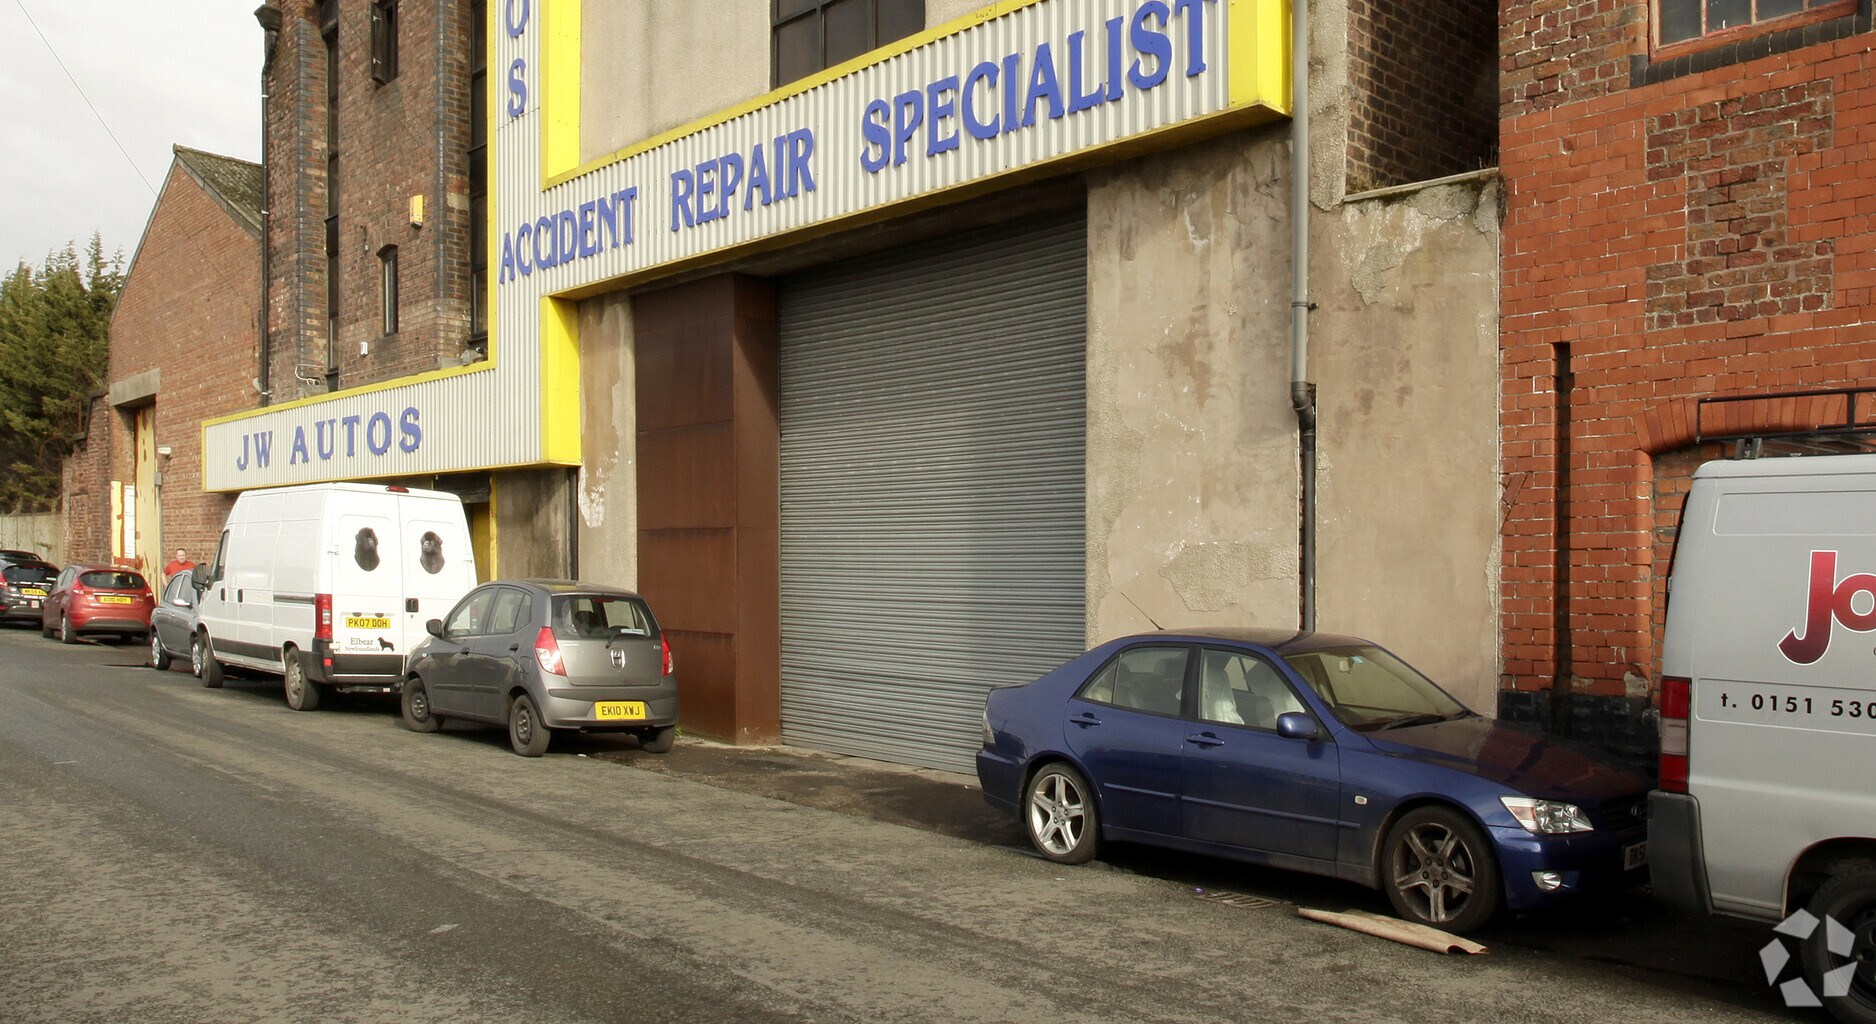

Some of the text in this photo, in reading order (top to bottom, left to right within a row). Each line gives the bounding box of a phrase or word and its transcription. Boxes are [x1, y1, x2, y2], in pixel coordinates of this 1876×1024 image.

[499, 185, 638, 284] ACCIDENT
[670, 127, 817, 232] REPAIR
[236, 406, 422, 471] JW AUTOS
[350, 637, 374, 645] Elbear
[601, 706, 621, 716] EK10
[1721, 693, 1876, 719] t. 0151 530
